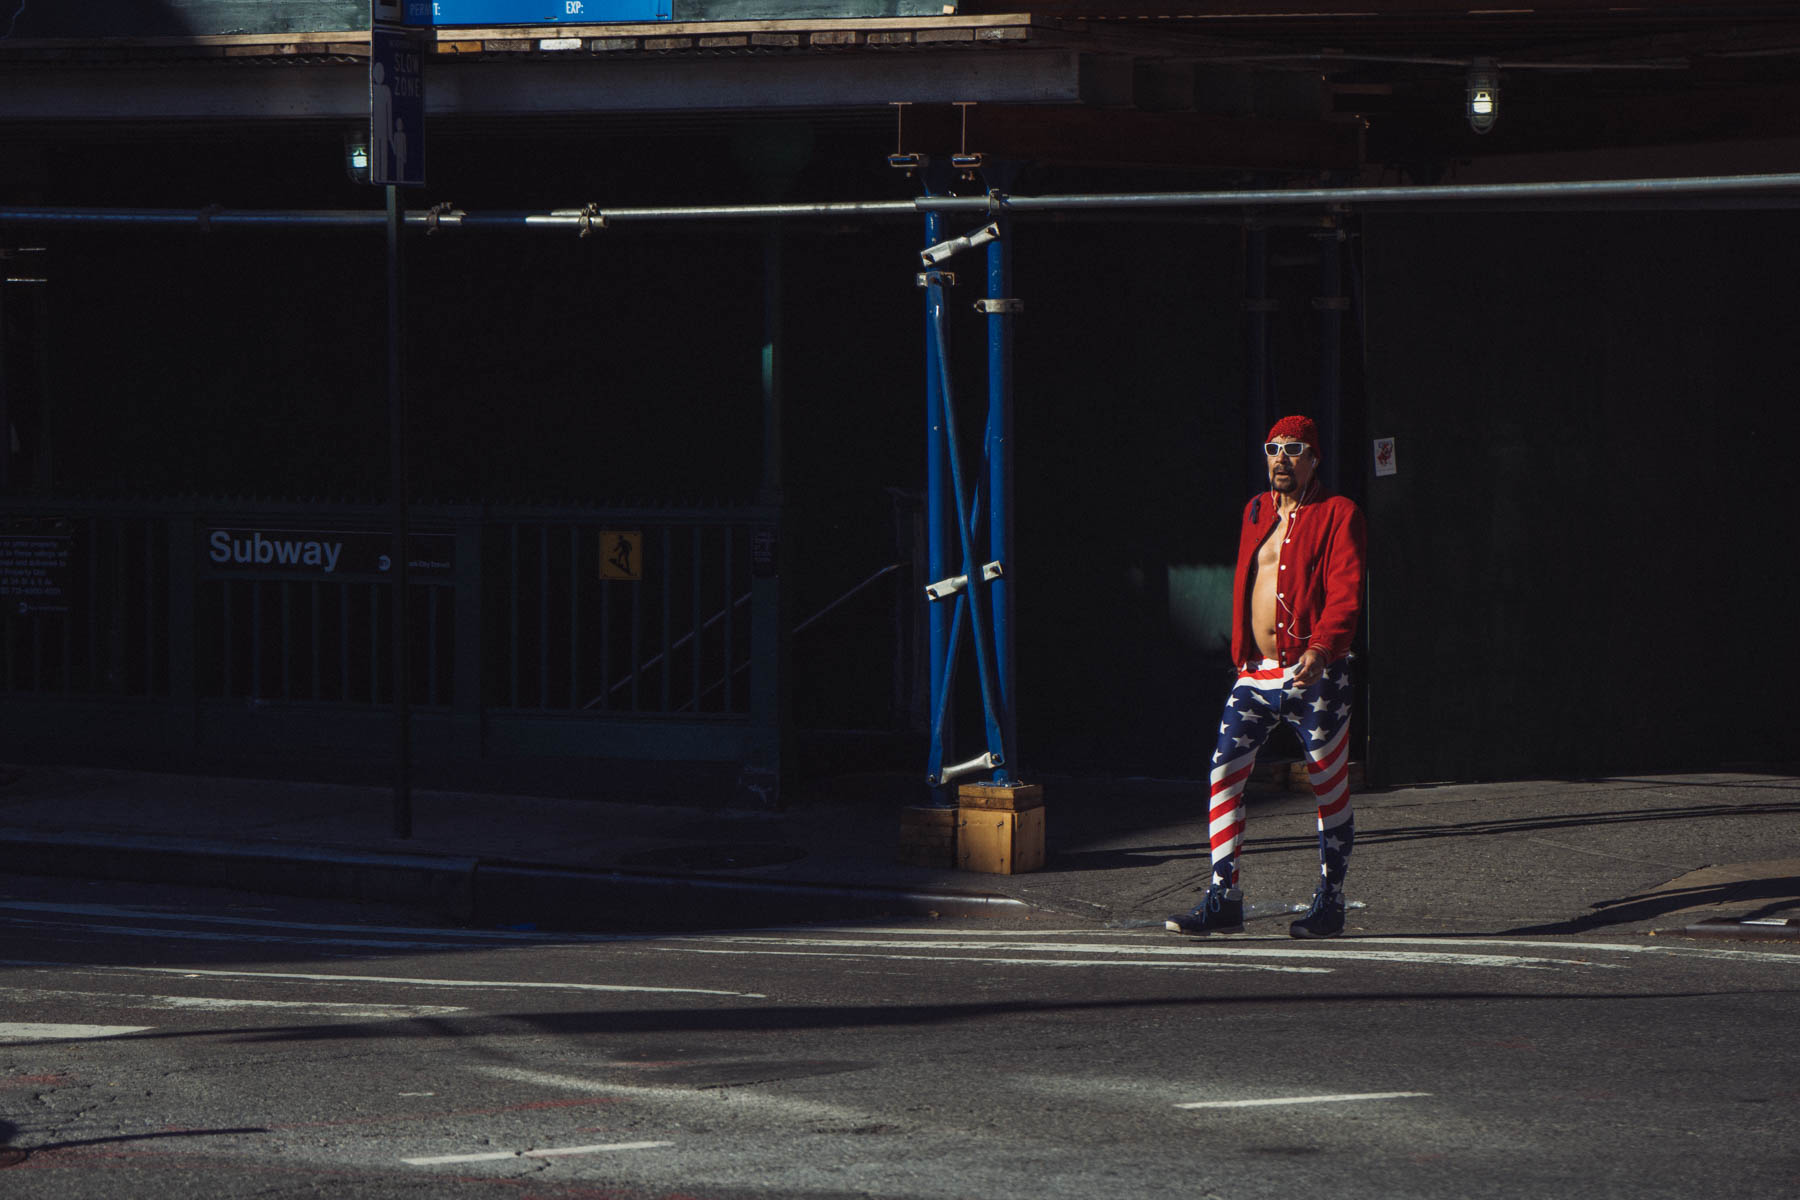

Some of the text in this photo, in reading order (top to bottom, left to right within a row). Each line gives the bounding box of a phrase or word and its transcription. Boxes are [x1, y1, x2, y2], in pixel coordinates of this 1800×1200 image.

[565, 1, 584, 15] EXP:
[393, 52, 419, 72] SLOW
[394, 76, 420, 97] ZONE
[209, 530, 343, 572] Subway
